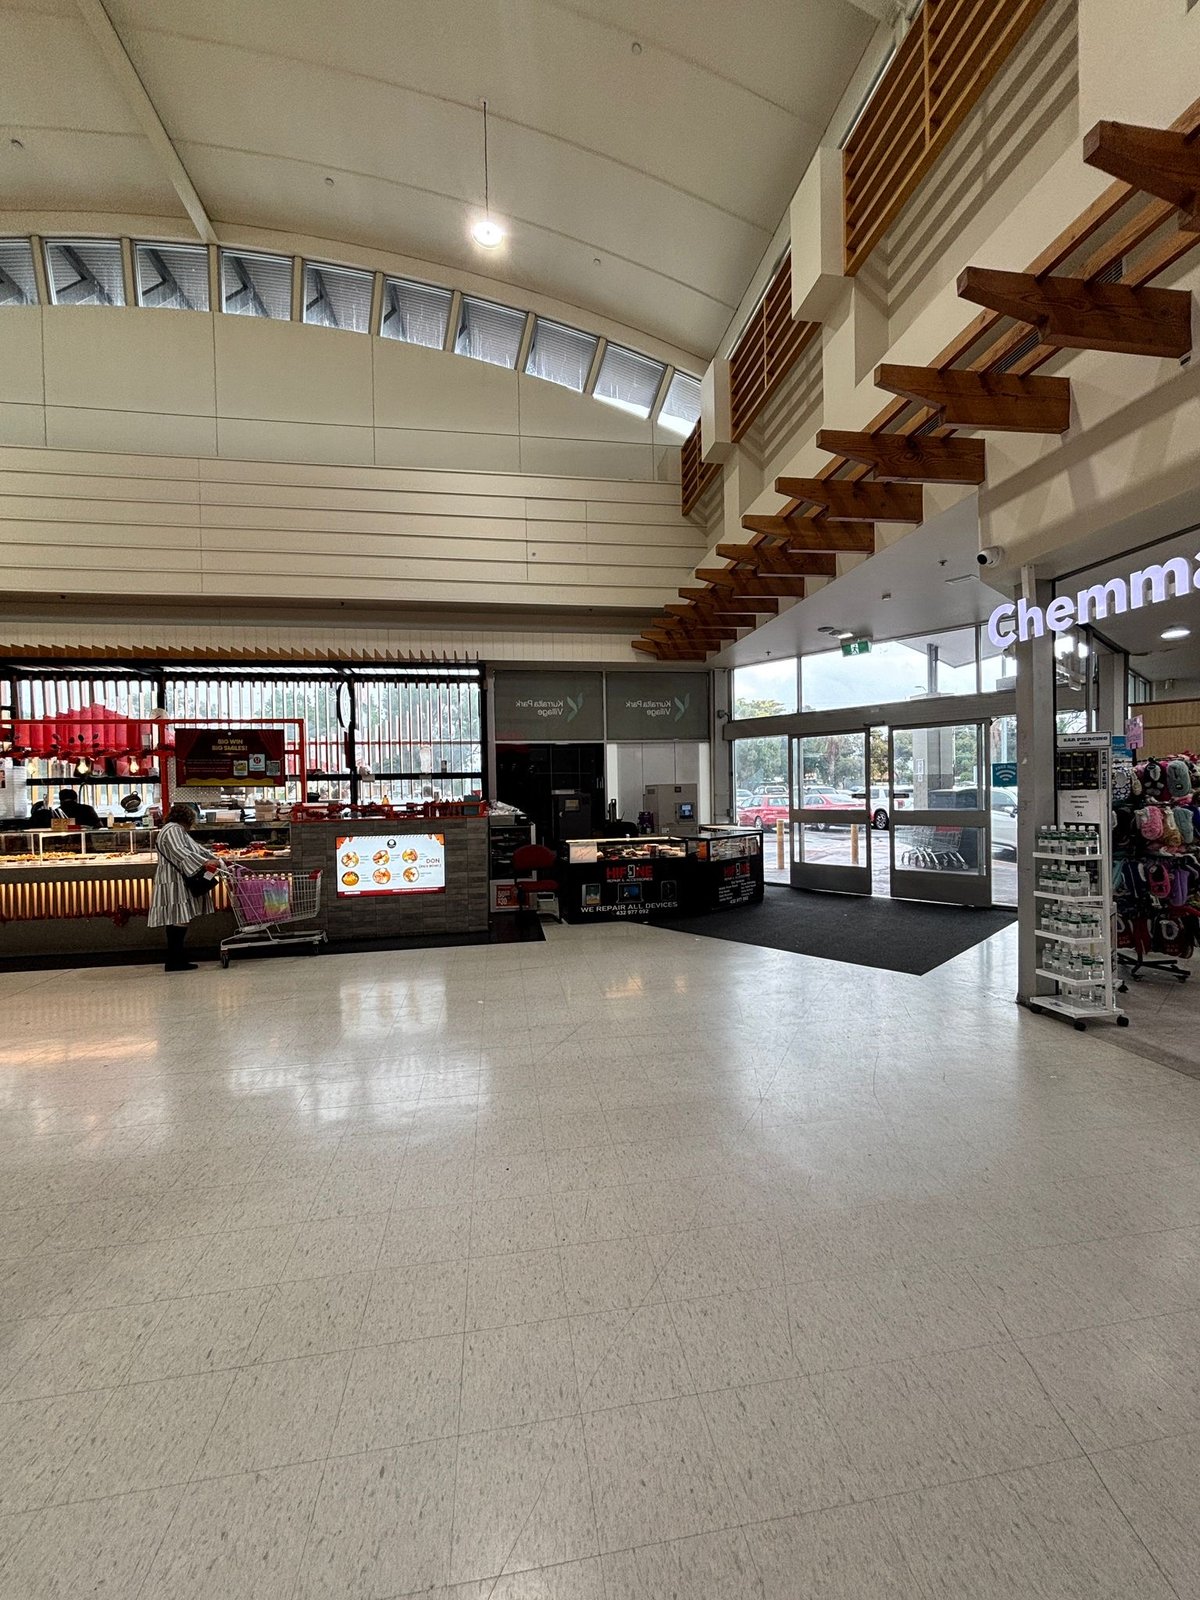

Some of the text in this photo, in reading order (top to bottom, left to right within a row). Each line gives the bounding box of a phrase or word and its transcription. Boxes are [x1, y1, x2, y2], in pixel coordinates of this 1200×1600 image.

[987, 553, 1200, 648] Chemm
[596, 904, 626, 912] REPAIR
[645, 901, 678, 909] DEVICES
